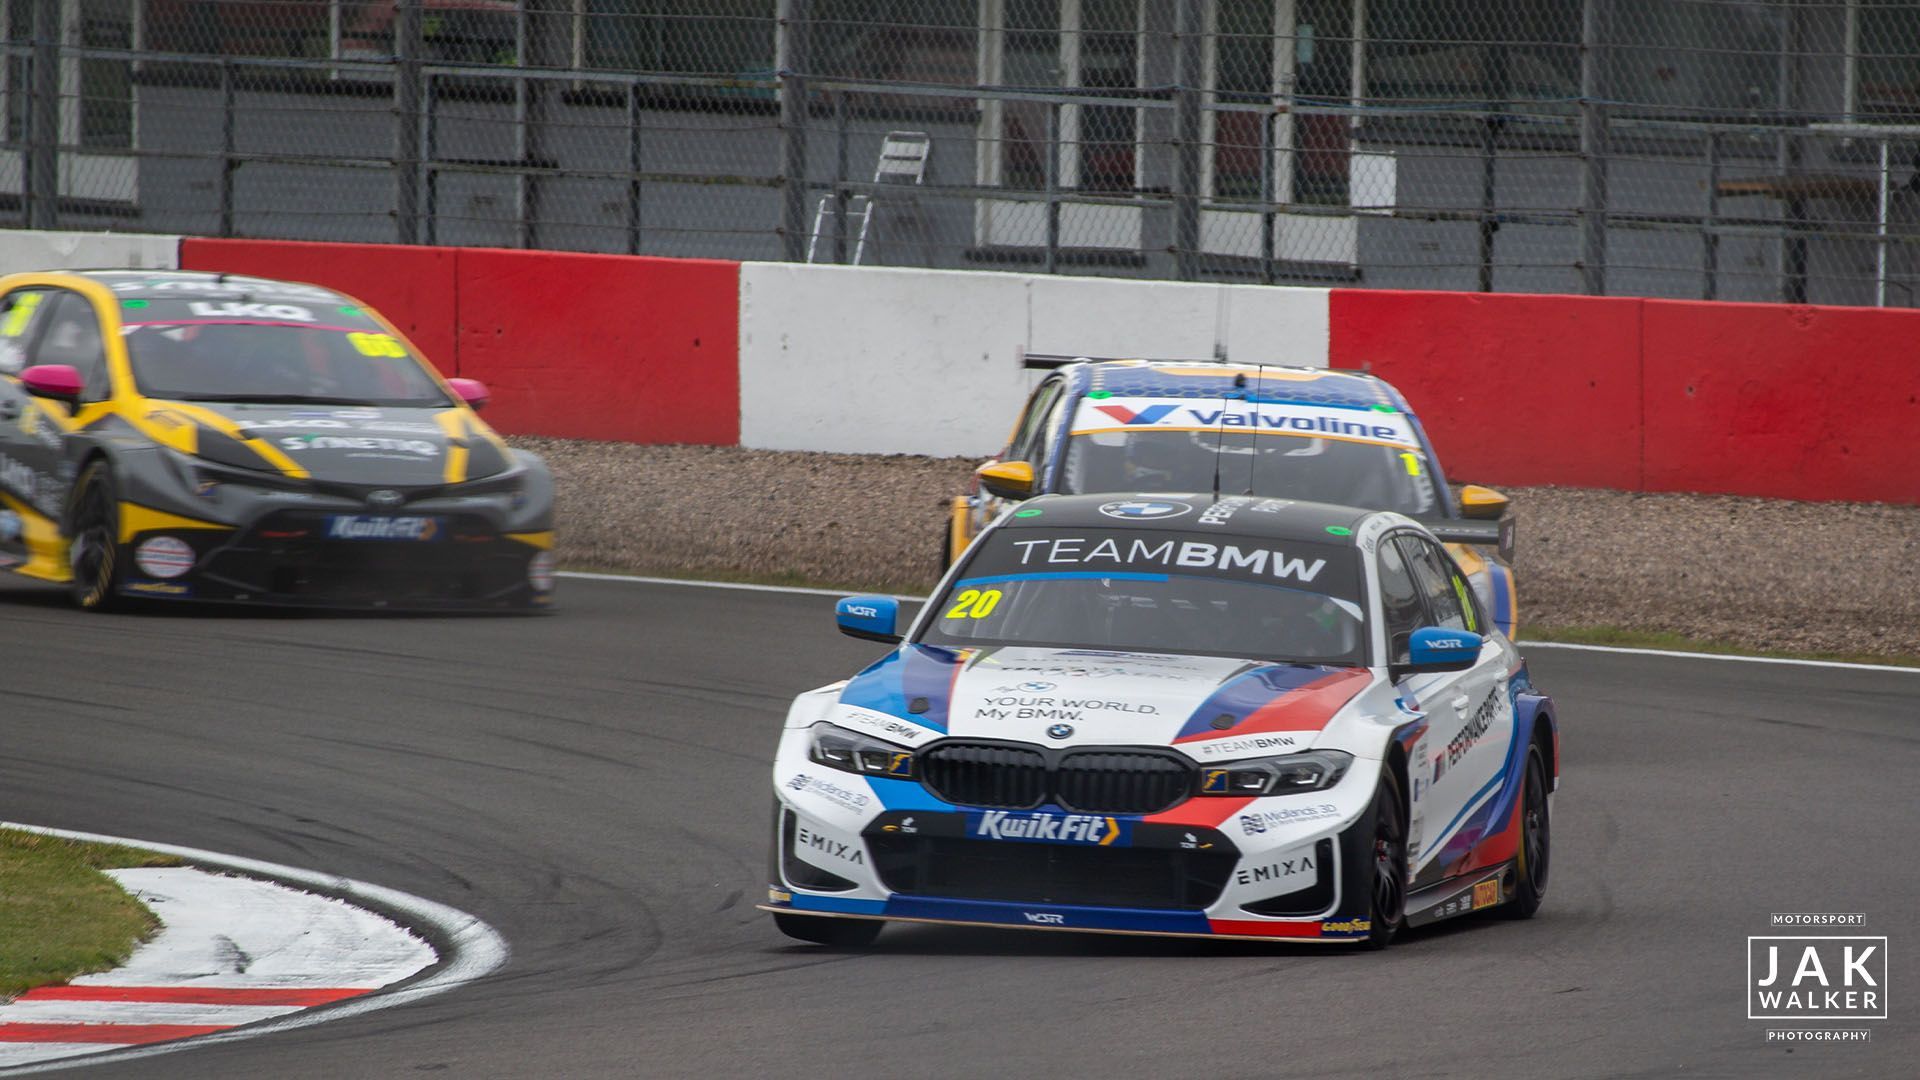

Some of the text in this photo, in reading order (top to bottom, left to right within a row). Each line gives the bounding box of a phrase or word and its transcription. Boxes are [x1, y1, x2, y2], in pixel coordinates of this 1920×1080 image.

[187, 302, 316, 322] LKQ
[1188, 408, 1396, 441] Valvoline
[1400, 453, 1419, 476] 1
[1013, 538, 1327, 582] TEAMBMW
[846, 604, 878, 618] WSR
[945, 589, 1003, 619] 20
[1424, 638, 1464, 648] WSR
[973, 708, 1086, 722] My BMW.
[984, 696, 1161, 717] YOUR WORLD.
[1202, 736, 1296, 754] #TEAMBMW
[1263, 808, 1317, 822] Midlands
[1318, 803, 1338, 813] 3D
[977, 810, 1104, 843] KwikFit
[799, 828, 864, 865] EMIXA
[1237, 857, 1315, 885] EMIXA
[1023, 912, 1065, 924] WSR
